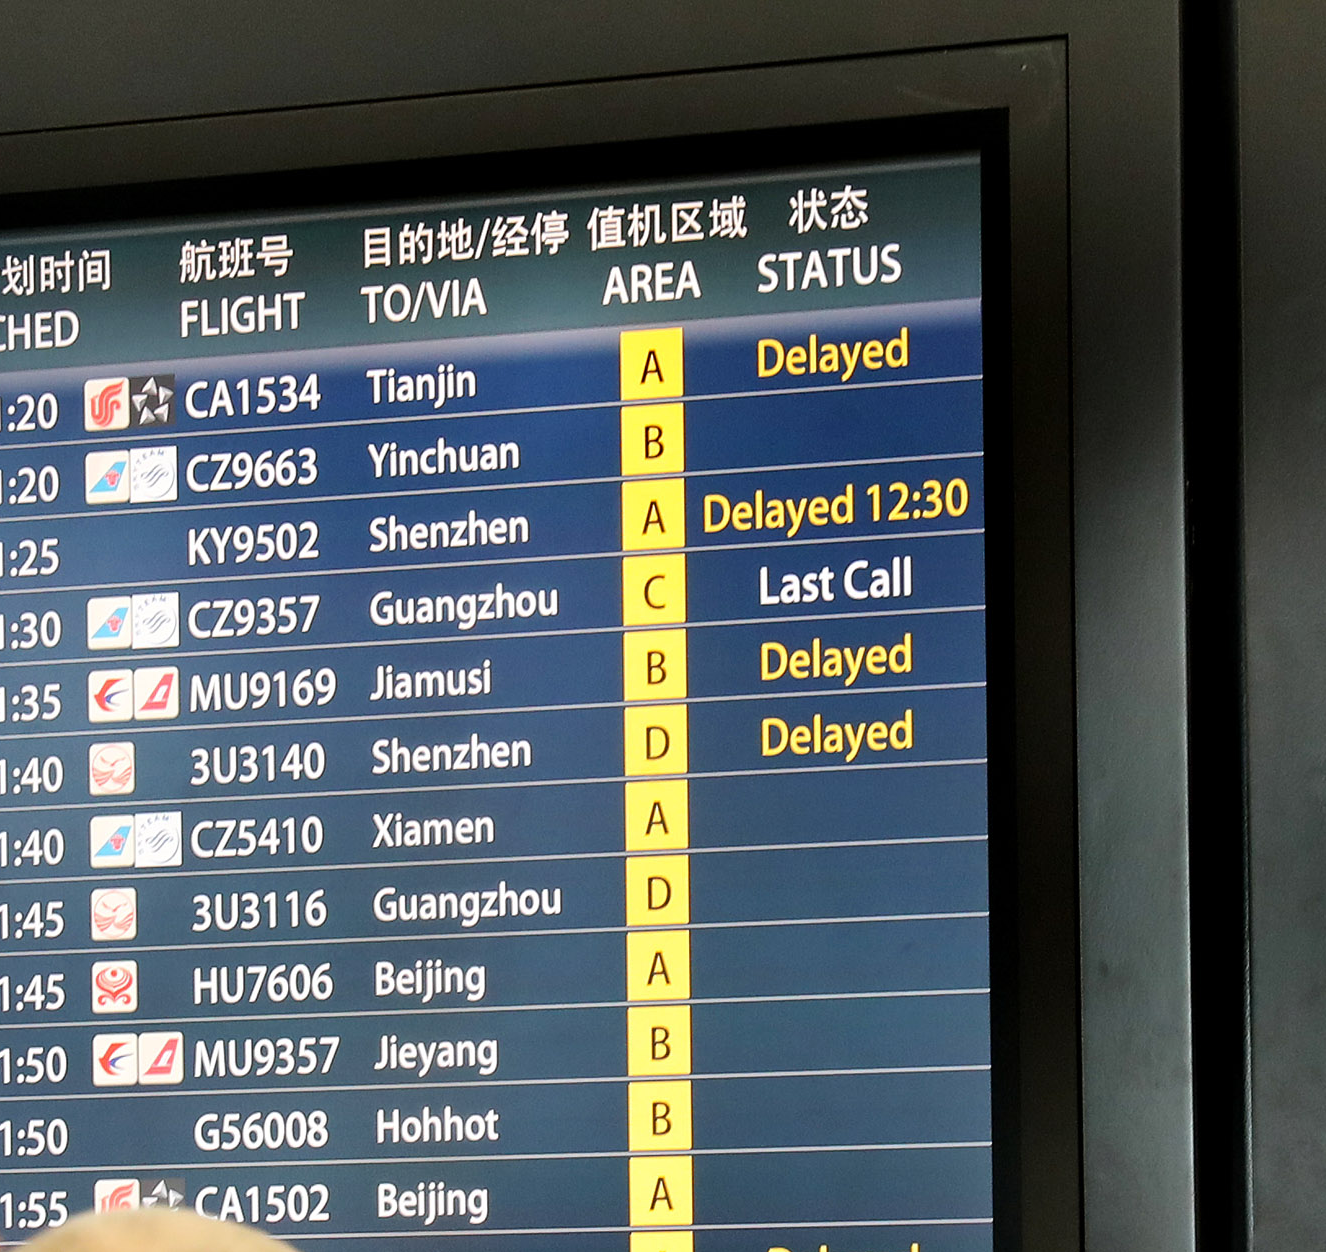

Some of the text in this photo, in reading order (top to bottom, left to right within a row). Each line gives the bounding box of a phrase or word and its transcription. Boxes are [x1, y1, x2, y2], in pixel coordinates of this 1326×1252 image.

[179, 234, 294, 284] 航班号
[364, 209, 570, 269] 目的地/经停
[586, 195, 748, 252] 值机区域
[788, 184, 869, 234] 状态
[180, 291, 306, 338] FLIGHT
[360, 277, 488, 324] TO/VIA
[602, 260, 702, 306] AREA
[757, 243, 902, 293] STATUS
[185, 373, 322, 419] CA1534
[365, 363, 476, 409] Tianjin
[640, 349, 665, 385] A
[757, 326, 909, 383] Delayed
[188, 520, 319, 566] KY9502
[369, 509, 529, 553] Shenzhen
[642, 500, 666, 535] A
[703, 483, 854, 539] Delayed
[866, 477, 969, 522] 12:30
[187, 594, 320, 639] CZ9357
[369, 582, 558, 631] Guangzhou
[643, 574, 666, 610] C
[759, 566, 835, 605] Last
[843, 555, 912, 600] Call
[190, 742, 325, 786] 3U3140
[372, 733, 532, 775] Shenzhen
[645, 725, 670, 761] D
[761, 708, 913, 763] Delayed
[194, 1110, 329, 1151] G56008
[376, 1105, 499, 1144] Hohhot
[652, 1101, 672, 1136] B
